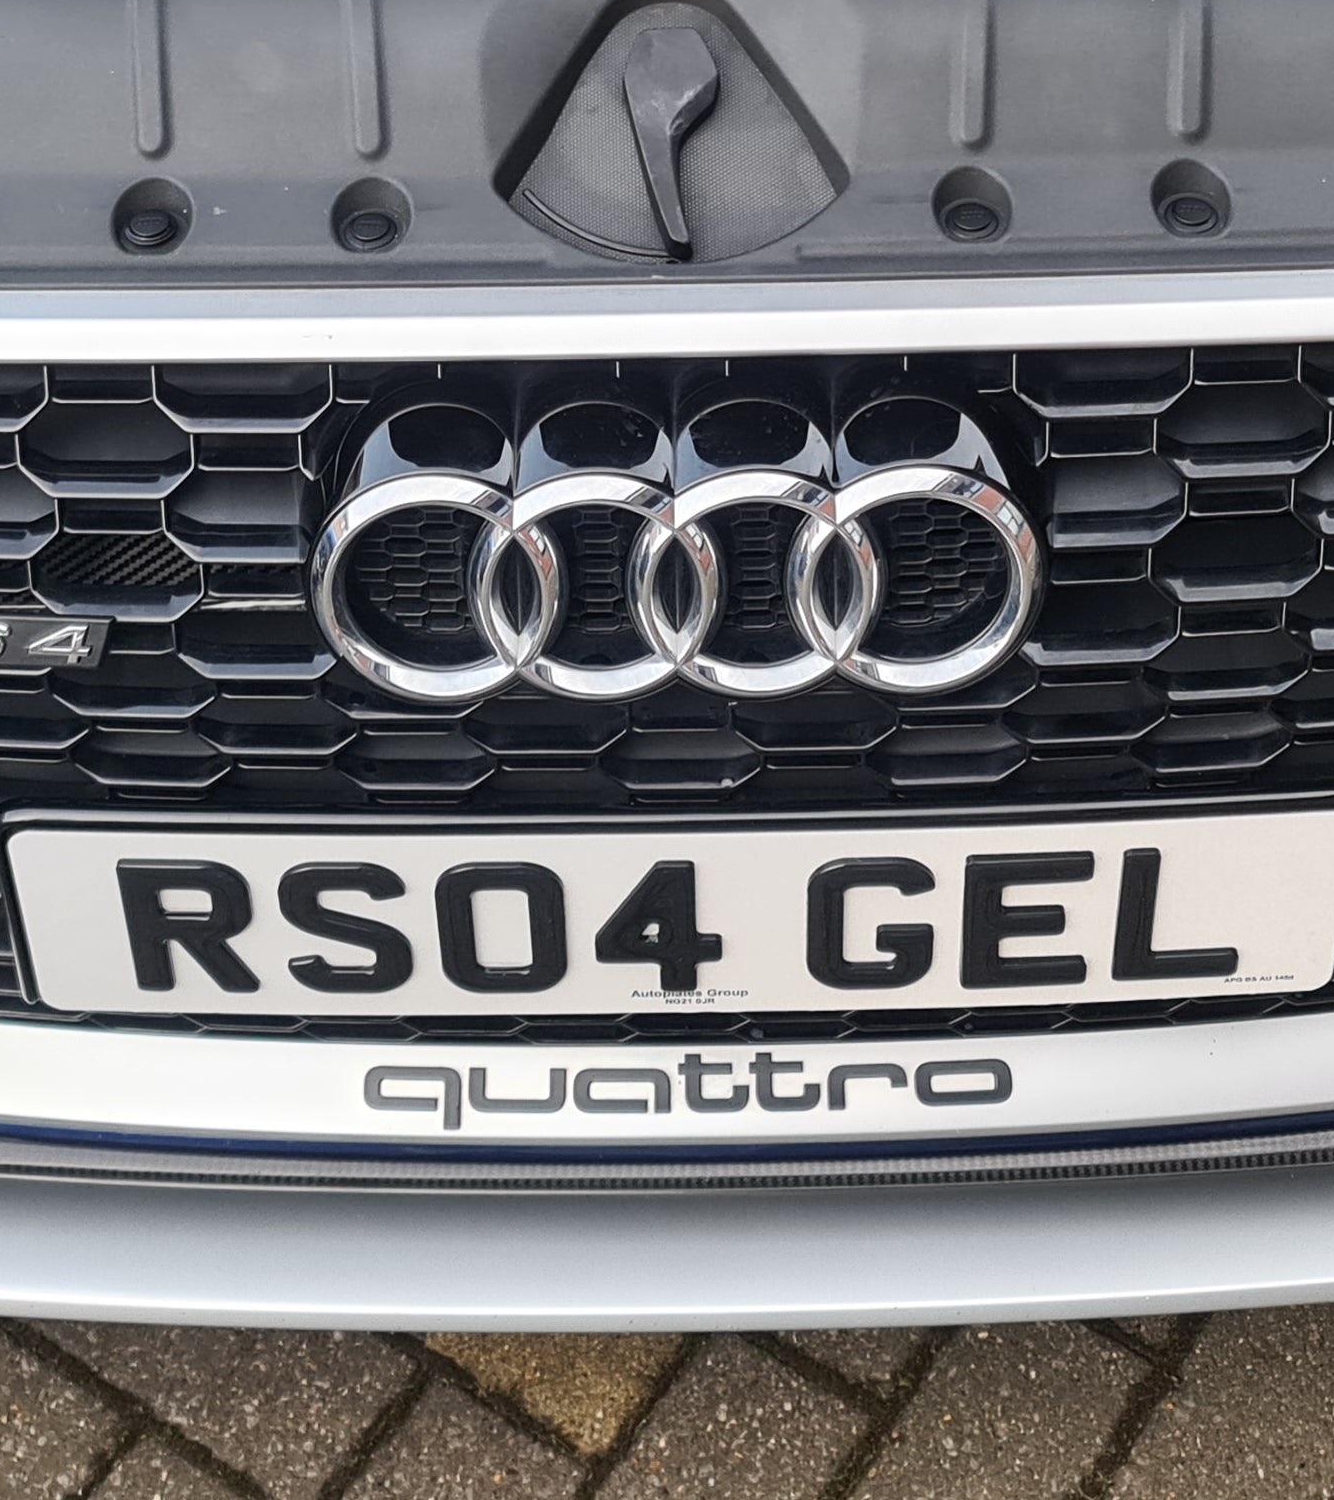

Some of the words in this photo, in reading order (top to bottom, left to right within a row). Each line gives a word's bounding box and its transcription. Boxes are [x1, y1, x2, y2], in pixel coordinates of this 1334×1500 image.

[28, 624, 92, 664] 4
[117, 859, 724, 993] RS04
[807, 848, 1239, 986] GEL
[707, 988, 749, 998] Group
[364, 1052, 1012, 1133] quattro
